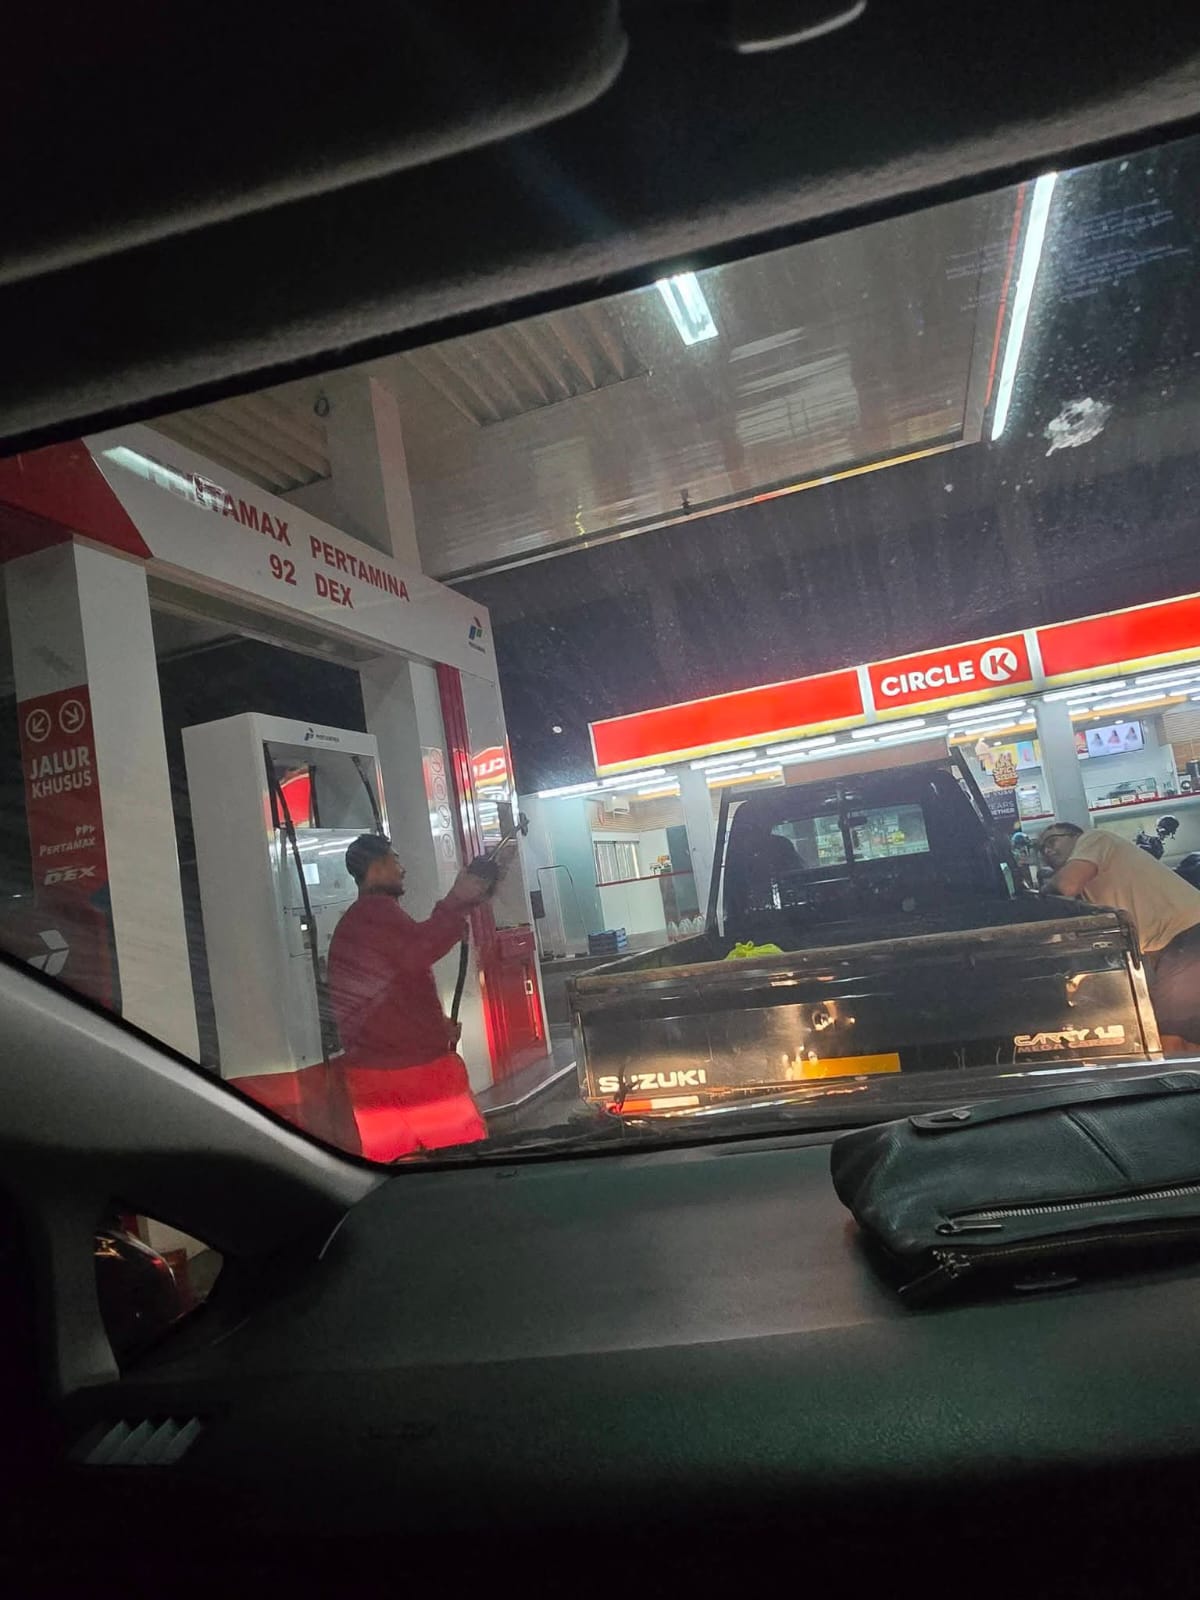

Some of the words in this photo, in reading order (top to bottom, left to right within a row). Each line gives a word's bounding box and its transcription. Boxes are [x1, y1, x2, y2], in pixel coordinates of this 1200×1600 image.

[269, 553, 297, 586] 92
[309, 535, 410, 602] PERTAMINA
[315, 572, 354, 608] DEX
[881, 660, 975, 696] CIRCLE
[985, 650, 1018, 680] K
[31, 746, 90, 780] JALUR
[32, 770, 92, 799] KHUSUS
[44, 866, 96, 885] DEX
